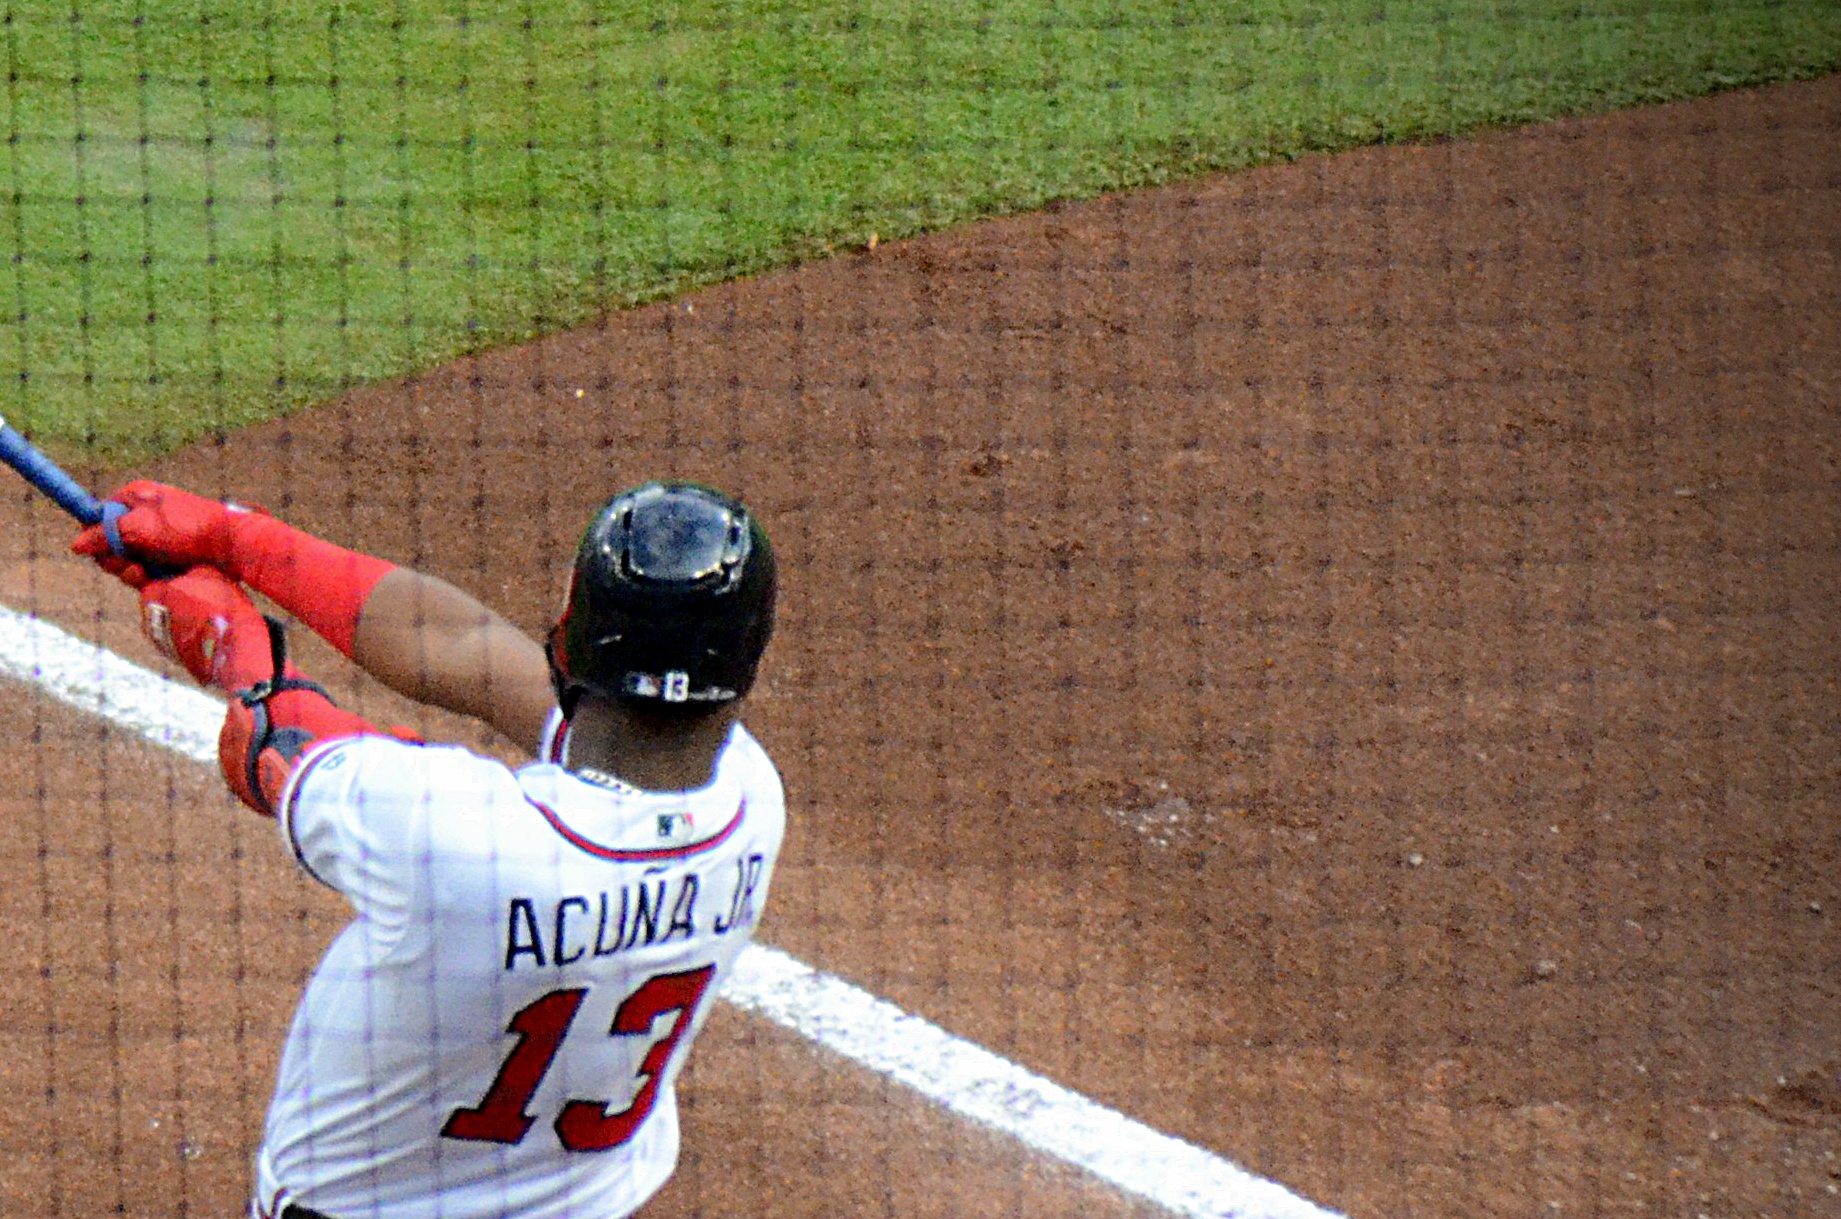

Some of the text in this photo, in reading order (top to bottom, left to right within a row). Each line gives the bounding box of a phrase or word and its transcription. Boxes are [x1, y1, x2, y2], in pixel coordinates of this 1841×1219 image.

[663, 671, 690, 702] 13
[505, 865, 700, 970] ACUÑA
[439, 962, 717, 1152] 13
